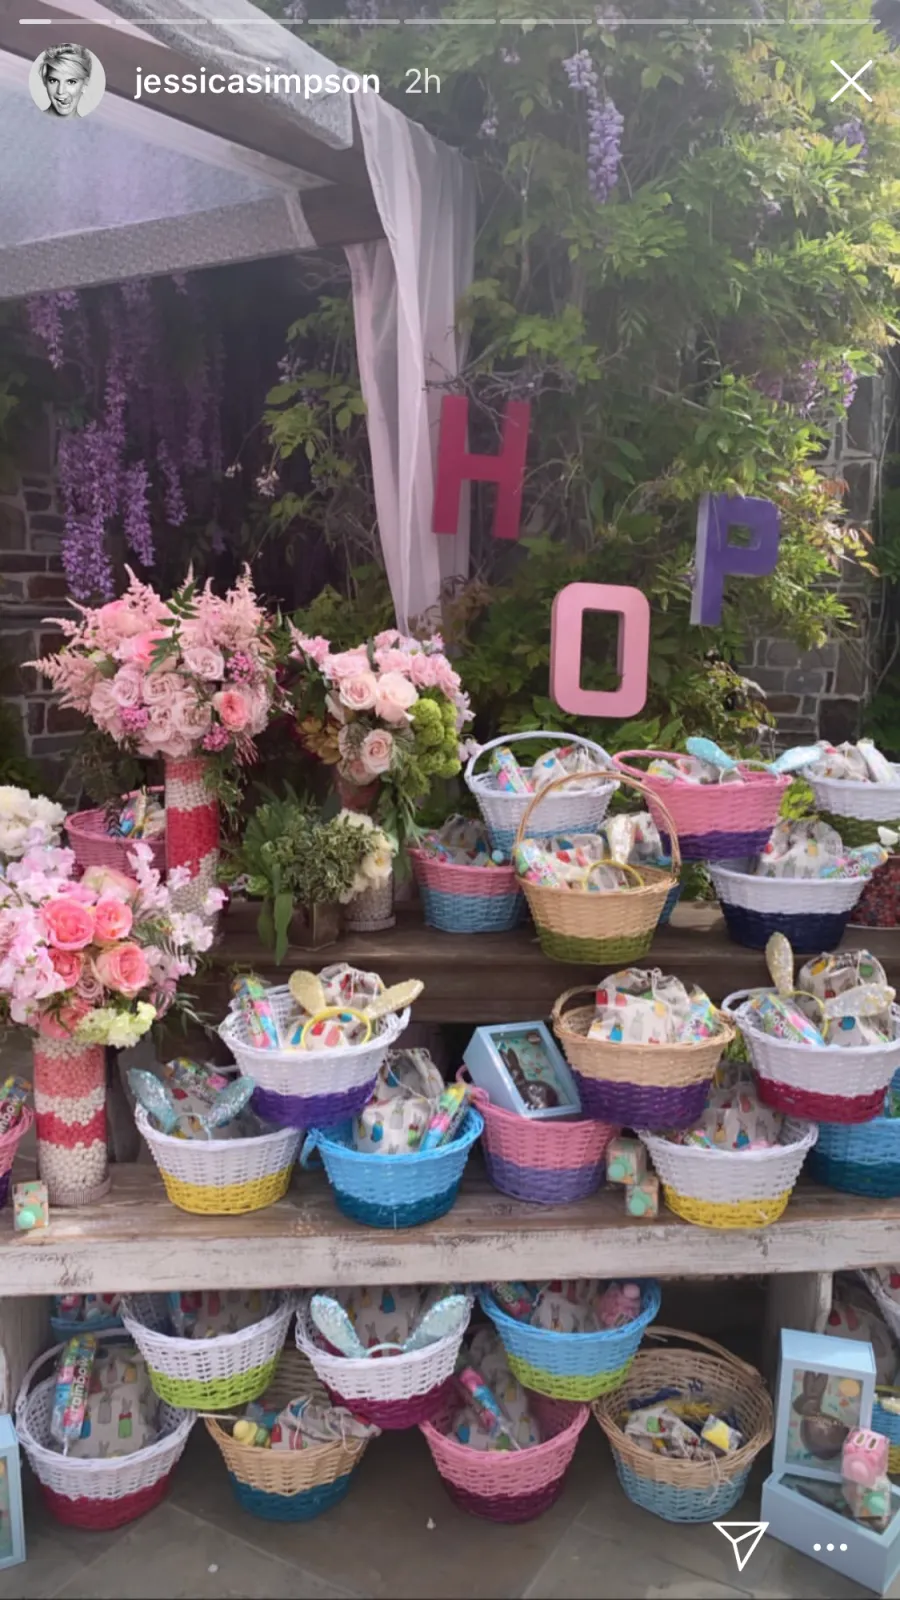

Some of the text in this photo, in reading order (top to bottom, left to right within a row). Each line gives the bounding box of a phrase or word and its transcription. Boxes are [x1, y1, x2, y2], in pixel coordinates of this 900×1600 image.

[431, 395, 781, 718] H O P
